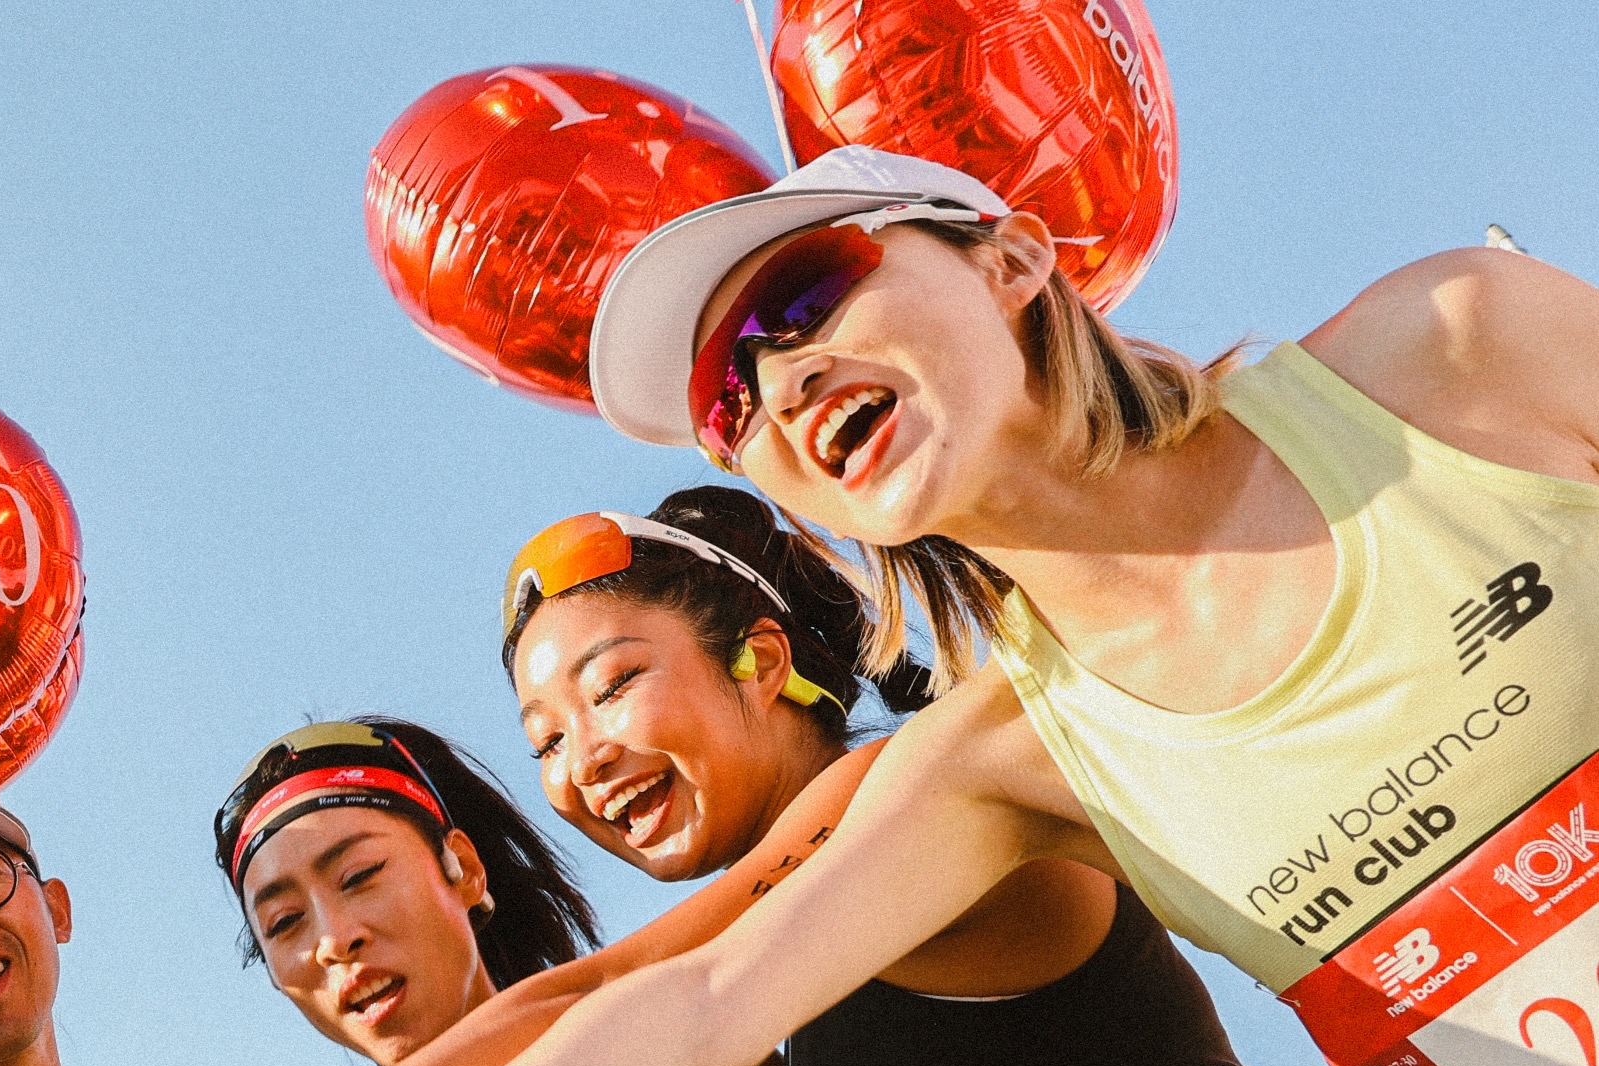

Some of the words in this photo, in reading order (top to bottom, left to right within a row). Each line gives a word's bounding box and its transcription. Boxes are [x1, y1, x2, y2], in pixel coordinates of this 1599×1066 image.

[1083, 0, 1173, 190] balanc
[1246, 835, 1330, 916] new
[1329, 684, 1530, 843] balance
[1493, 802, 1599, 903] 10K
[1280, 885, 1354, 946] run
[1354, 803, 1456, 886] club
[1386, 994, 1415, 1018] new
[1409, 951, 1478, 1001] balance
